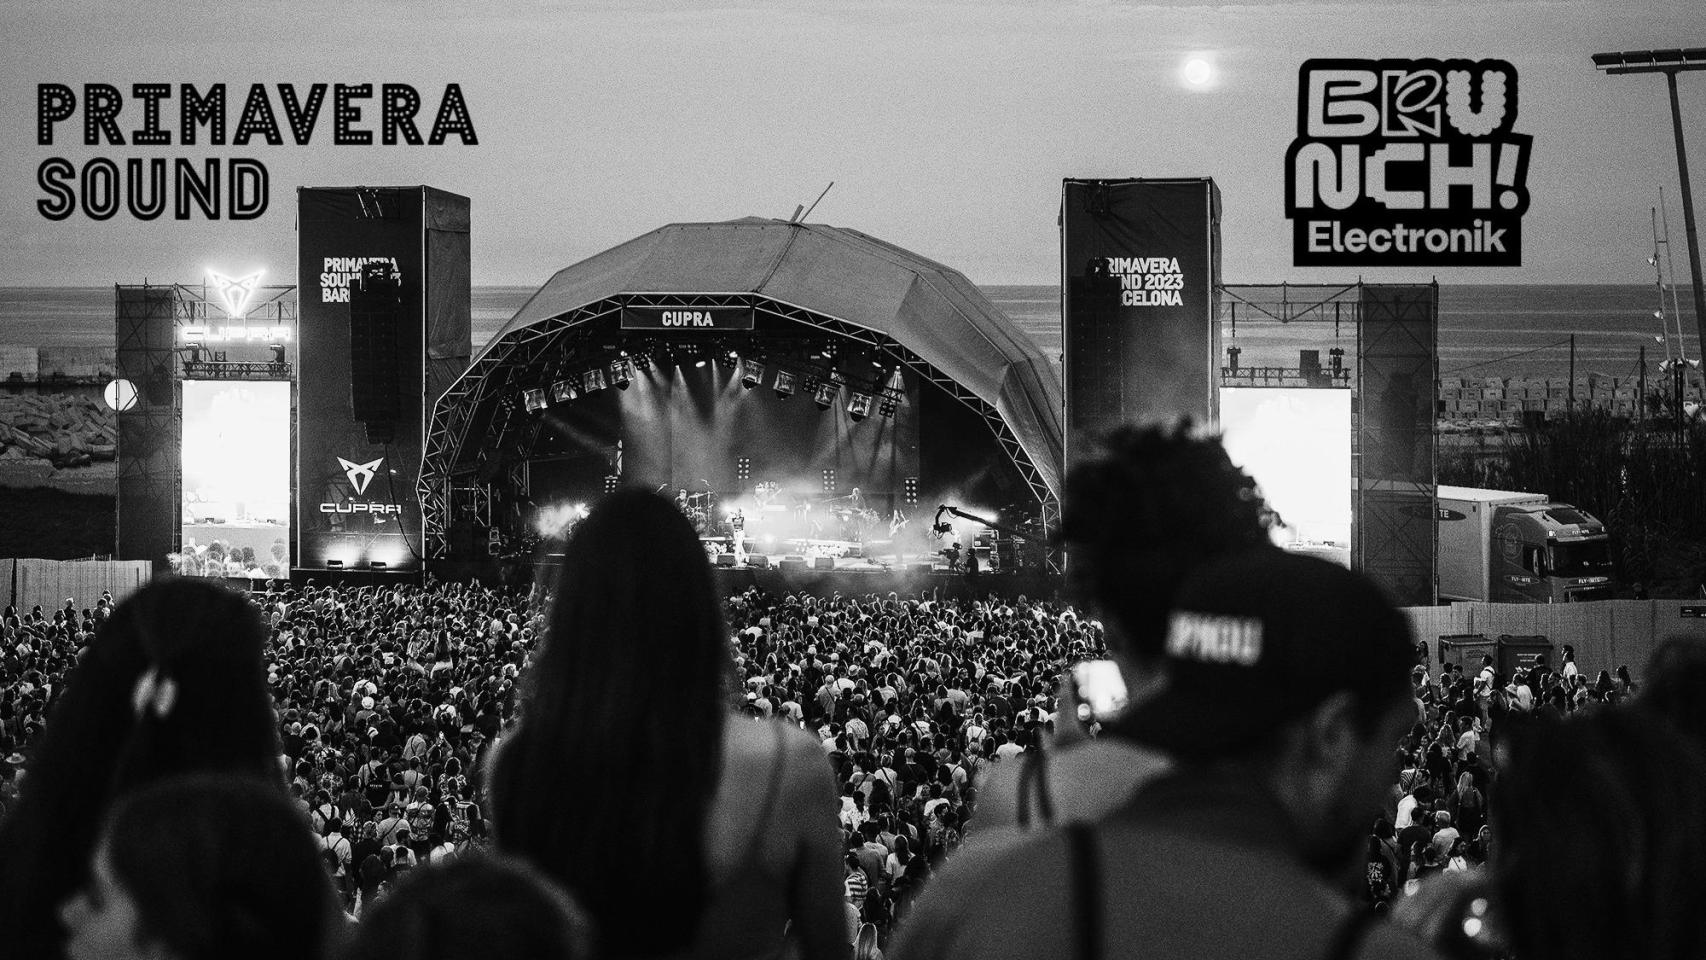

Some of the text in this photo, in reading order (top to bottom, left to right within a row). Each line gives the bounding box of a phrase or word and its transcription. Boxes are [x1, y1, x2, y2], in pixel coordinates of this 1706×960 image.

[1107, 257, 1182, 274] RIMAVERA
[1144, 273, 1184, 290] 2023
[1122, 290, 1184, 306] CELONA
[661, 311, 714, 327] CUPRA
[320, 503, 402, 514] CUPRA
